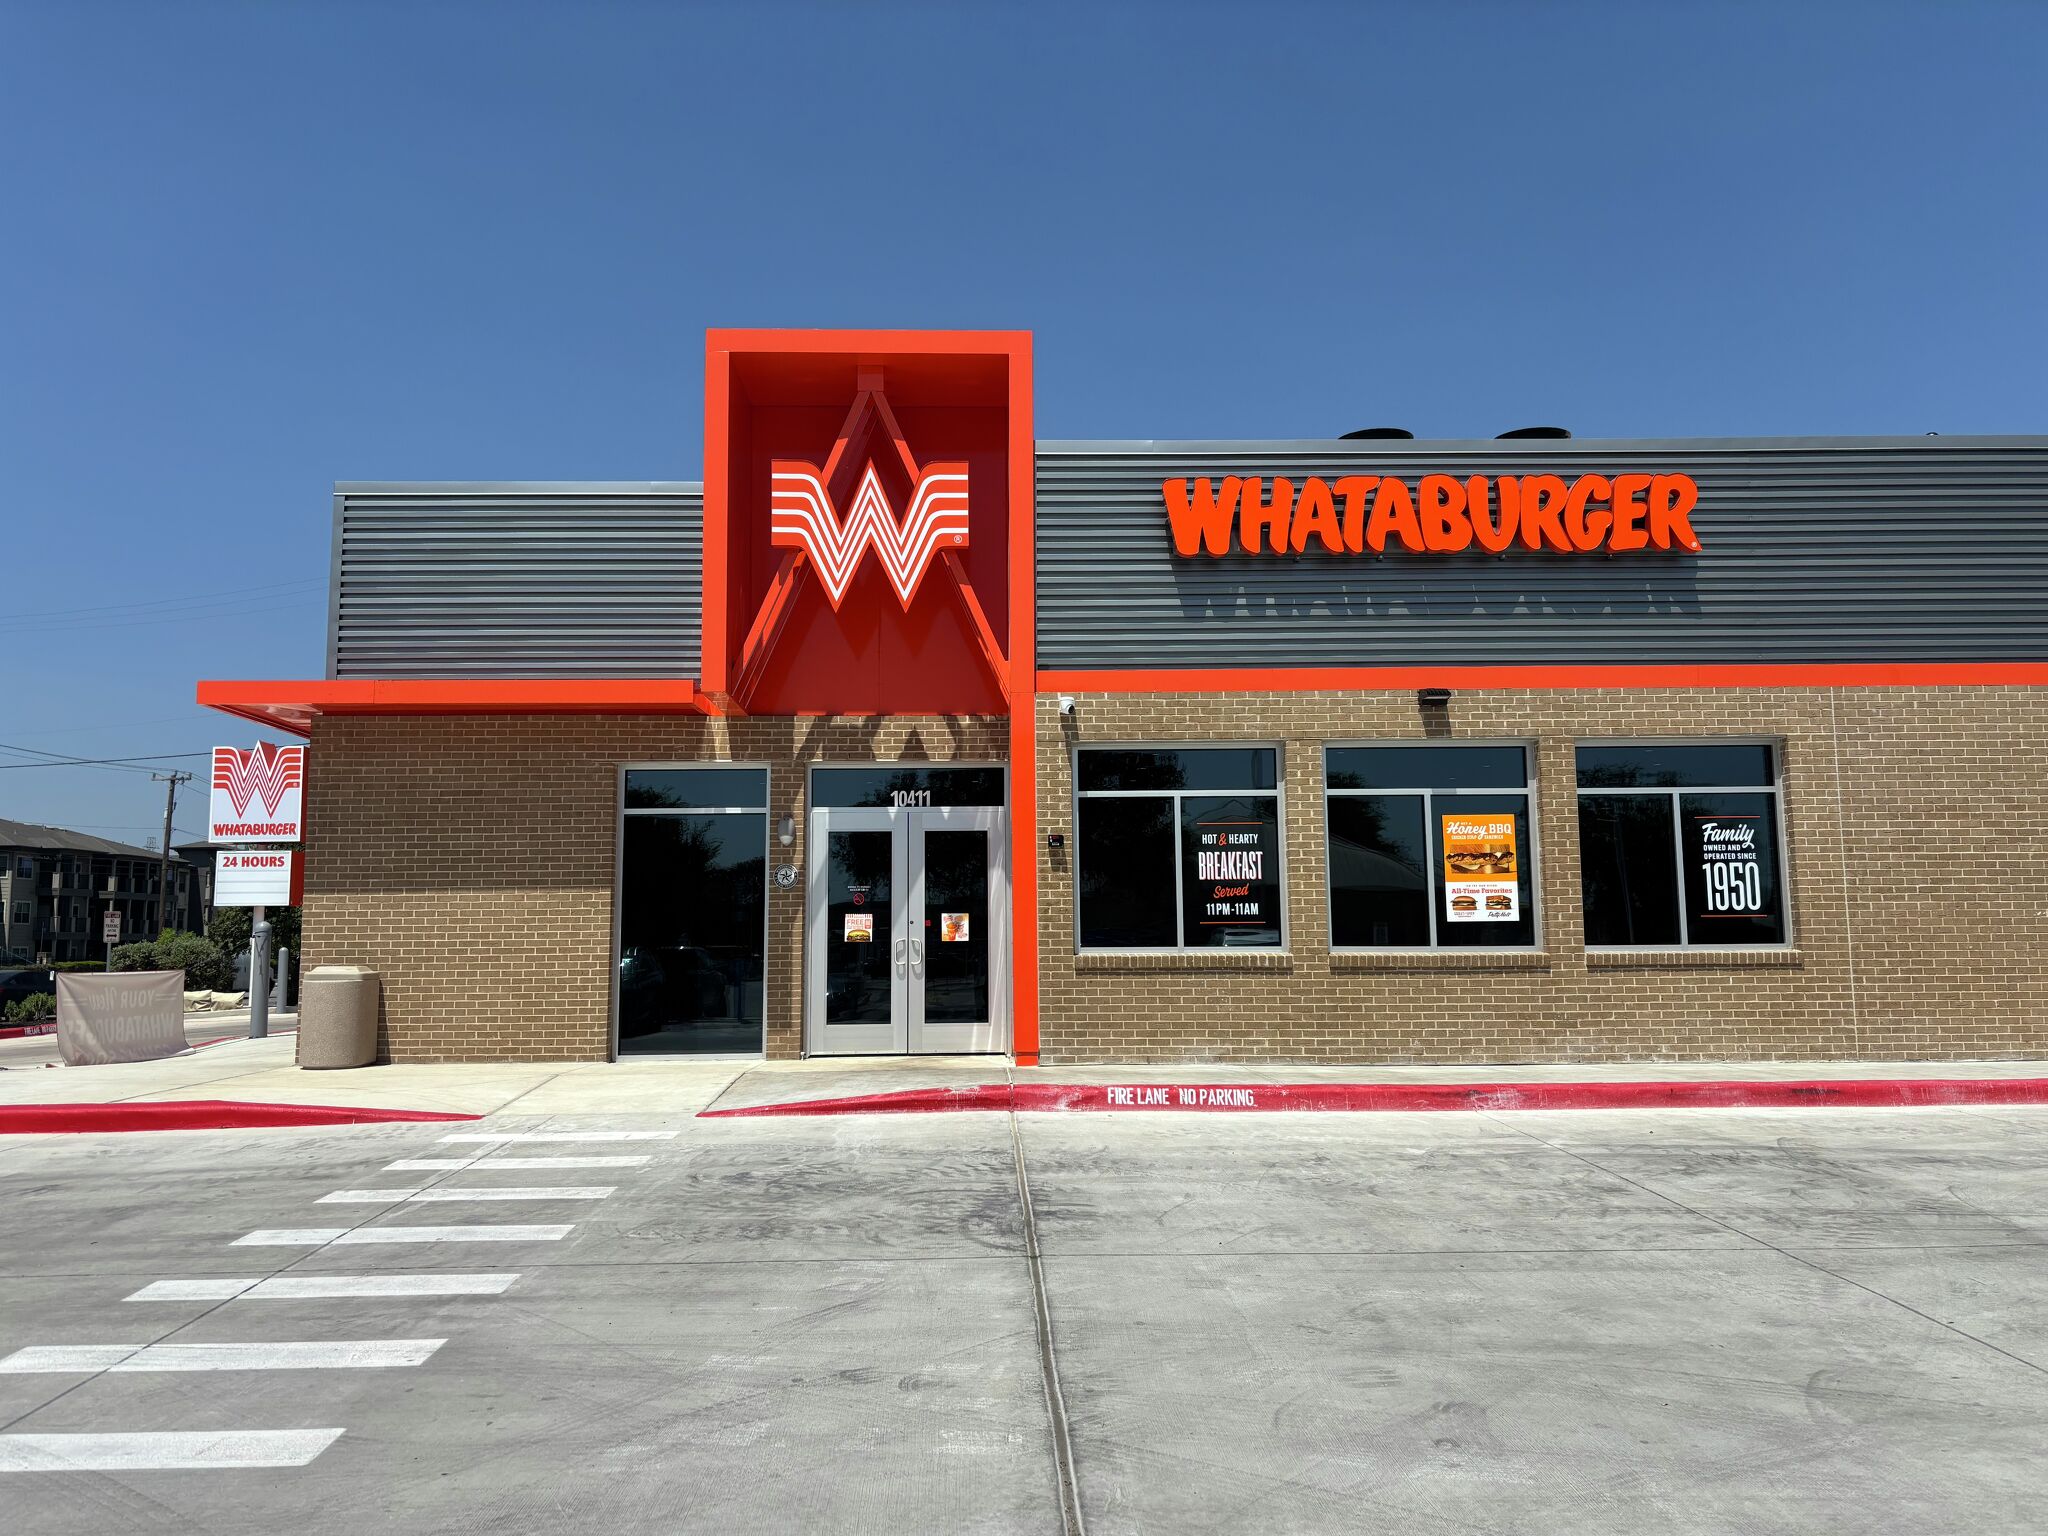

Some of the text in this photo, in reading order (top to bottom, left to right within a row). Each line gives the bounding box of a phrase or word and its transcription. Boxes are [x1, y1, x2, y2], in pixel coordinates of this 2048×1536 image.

[1162, 473, 1701, 557] WHATABURGER
[890, 790, 931, 807] 10411
[213, 823, 297, 837] WHATABURGER
[1446, 821, 1513, 840] Honey BBQ
[1701, 822, 1755, 850] Family
[1202, 833, 1259, 846] HOT & HEARTY
[222, 856, 285, 867] 24 HOURS
[1703, 852, 1757, 860] OPERATED SINCE
[1198, 850, 1264, 880] BREAKFAST
[1213, 883, 1250, 899] Served
[1702, 861, 1761, 911] 1950
[1206, 903, 1259, 915] 11PM-11AM
[1107, 1087, 1254, 1106] FIRE LANE NO PARKING
